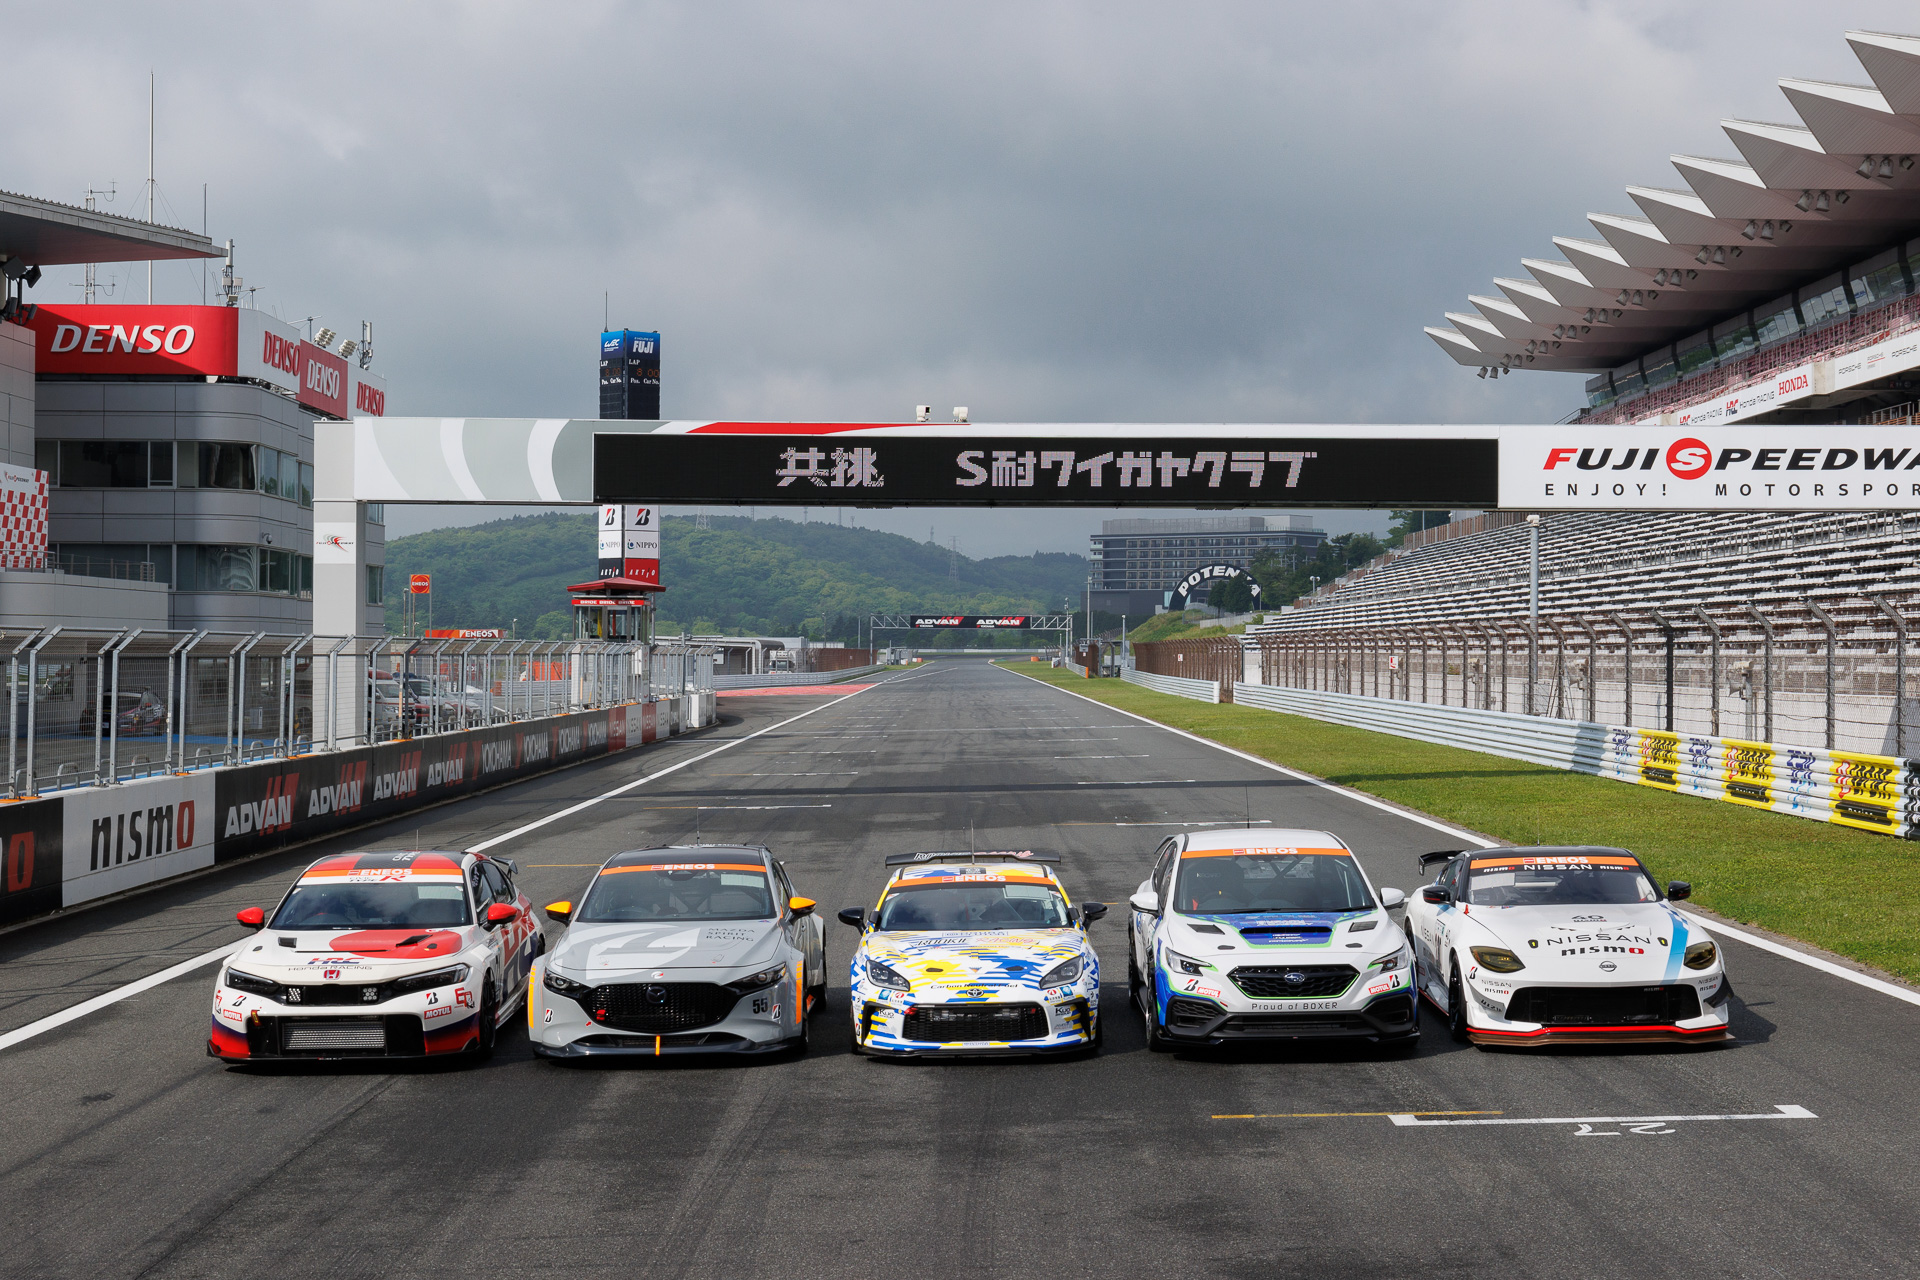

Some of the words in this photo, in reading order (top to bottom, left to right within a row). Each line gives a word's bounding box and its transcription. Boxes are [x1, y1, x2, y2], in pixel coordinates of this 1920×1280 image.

[51, 324, 195, 354] DENSO
[632, 340, 654, 354] FUJI
[263, 330, 300, 376] DENSO
[307, 359, 339, 399] DENSO
[1778, 374, 1809, 396] HONDA
[357, 381, 384, 417] DENSO
[776, 447, 885, 488] 共挑
[955, 451, 1318, 488] S耐ワイガヤクラブ
[1543, 448, 1660, 471] FUJI
[1545, 483, 1667, 496] ENJOY!
[636, 541, 657, 549] NIPPO
[600, 566, 619, 577] AKTIO
[629, 567, 655, 578] AKTIO
[1178, 565, 1260, 597] POTENA
[523, 732, 549, 763] YOKOHAMA
[559, 725, 581, 755] YOKOHAMA
[482, 739, 512, 774] YOKOHAMA
[373, 768, 417, 800] ADVAN
[427, 758, 463, 787] ADVAN
[308, 780, 361, 818] ADVAN
[224, 795, 291, 838] ADVAN
[90, 800, 195, 871] nismo
[1547, 933, 1651, 946] NISSAN
[1562, 945, 1644, 956] nismo
[1198, 987, 1219, 996] MOTUL
[1370, 984, 1390, 994] MOTUL
[1482, 979, 1512, 987] NISSAN
[426, 1007, 451, 1018] MOTUL
[752, 997, 768, 1014] 55
